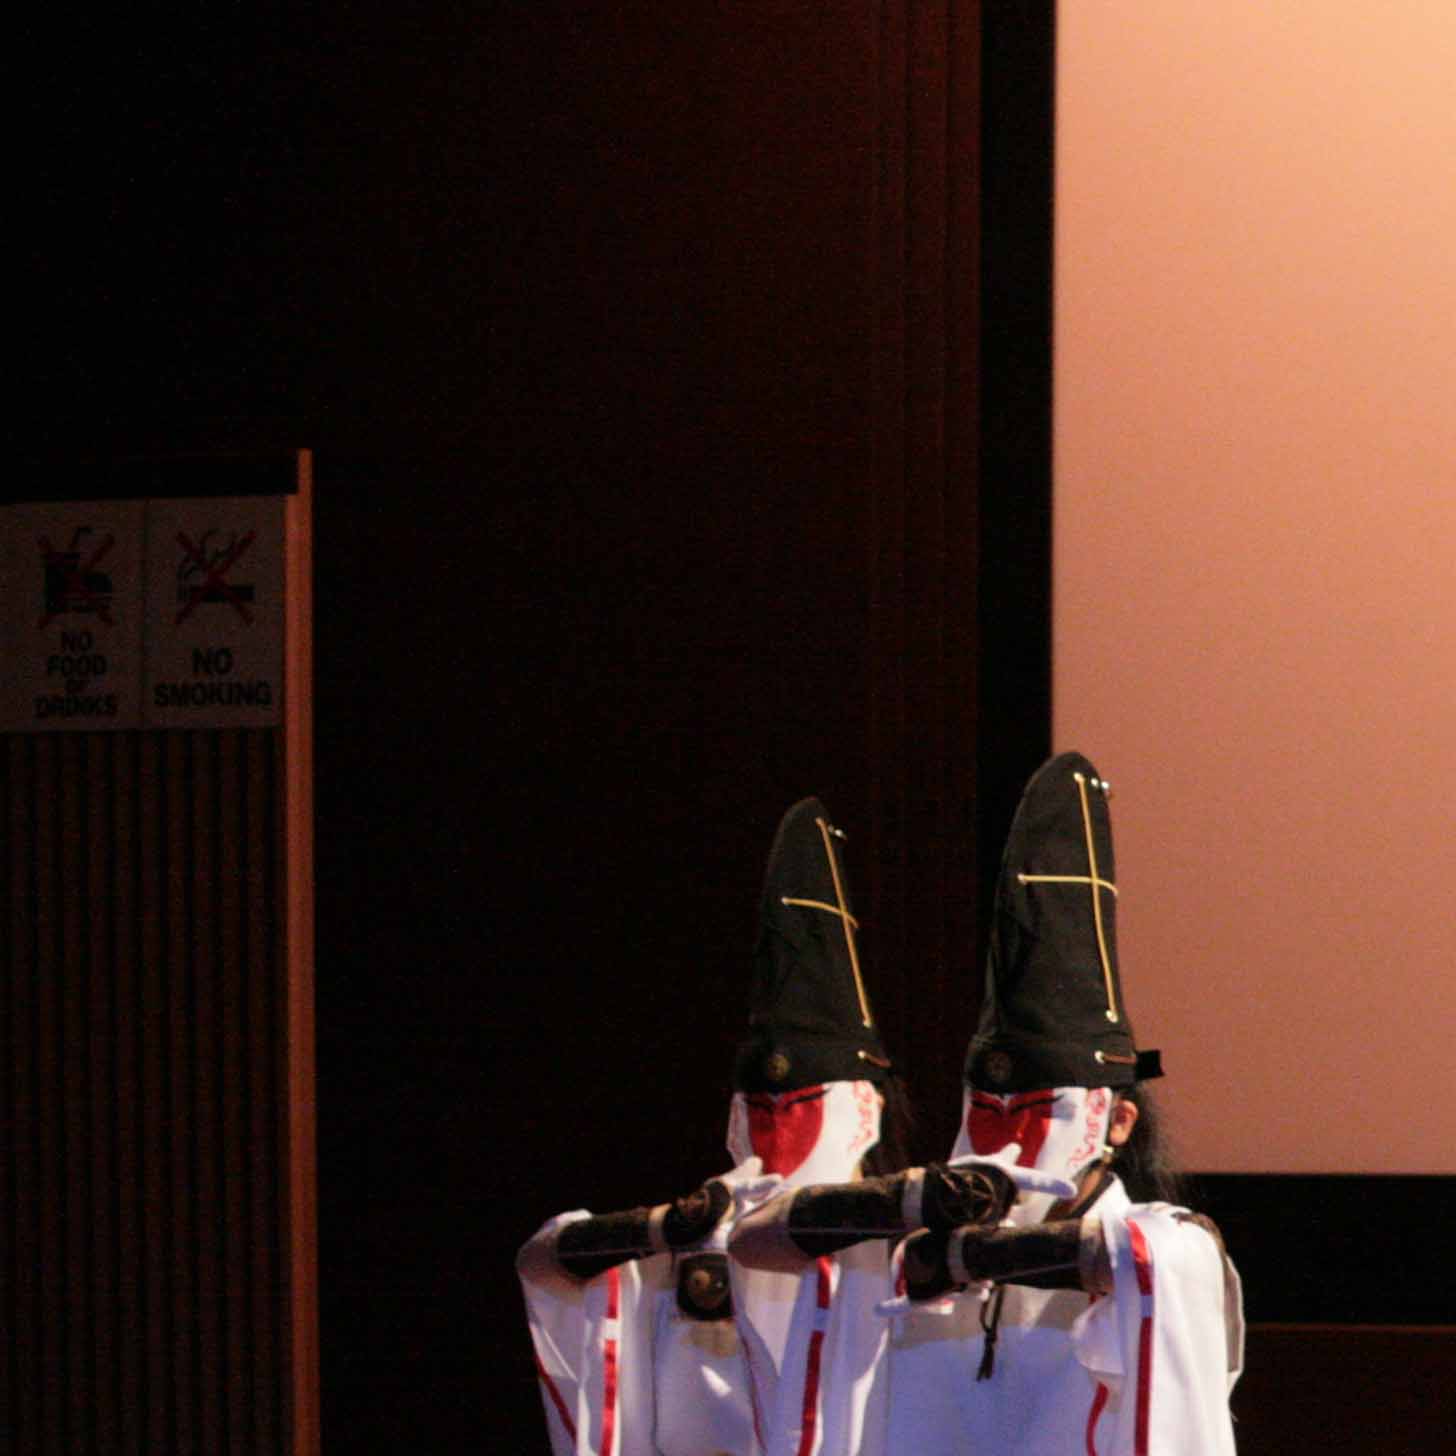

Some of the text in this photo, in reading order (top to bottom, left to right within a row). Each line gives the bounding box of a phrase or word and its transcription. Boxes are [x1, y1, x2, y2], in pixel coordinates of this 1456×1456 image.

[61, 631, 93, 651] NO
[47, 654, 107, 677] FOOD
[193, 647, 234, 674] NO
[154, 682, 273, 707] SMOKING
